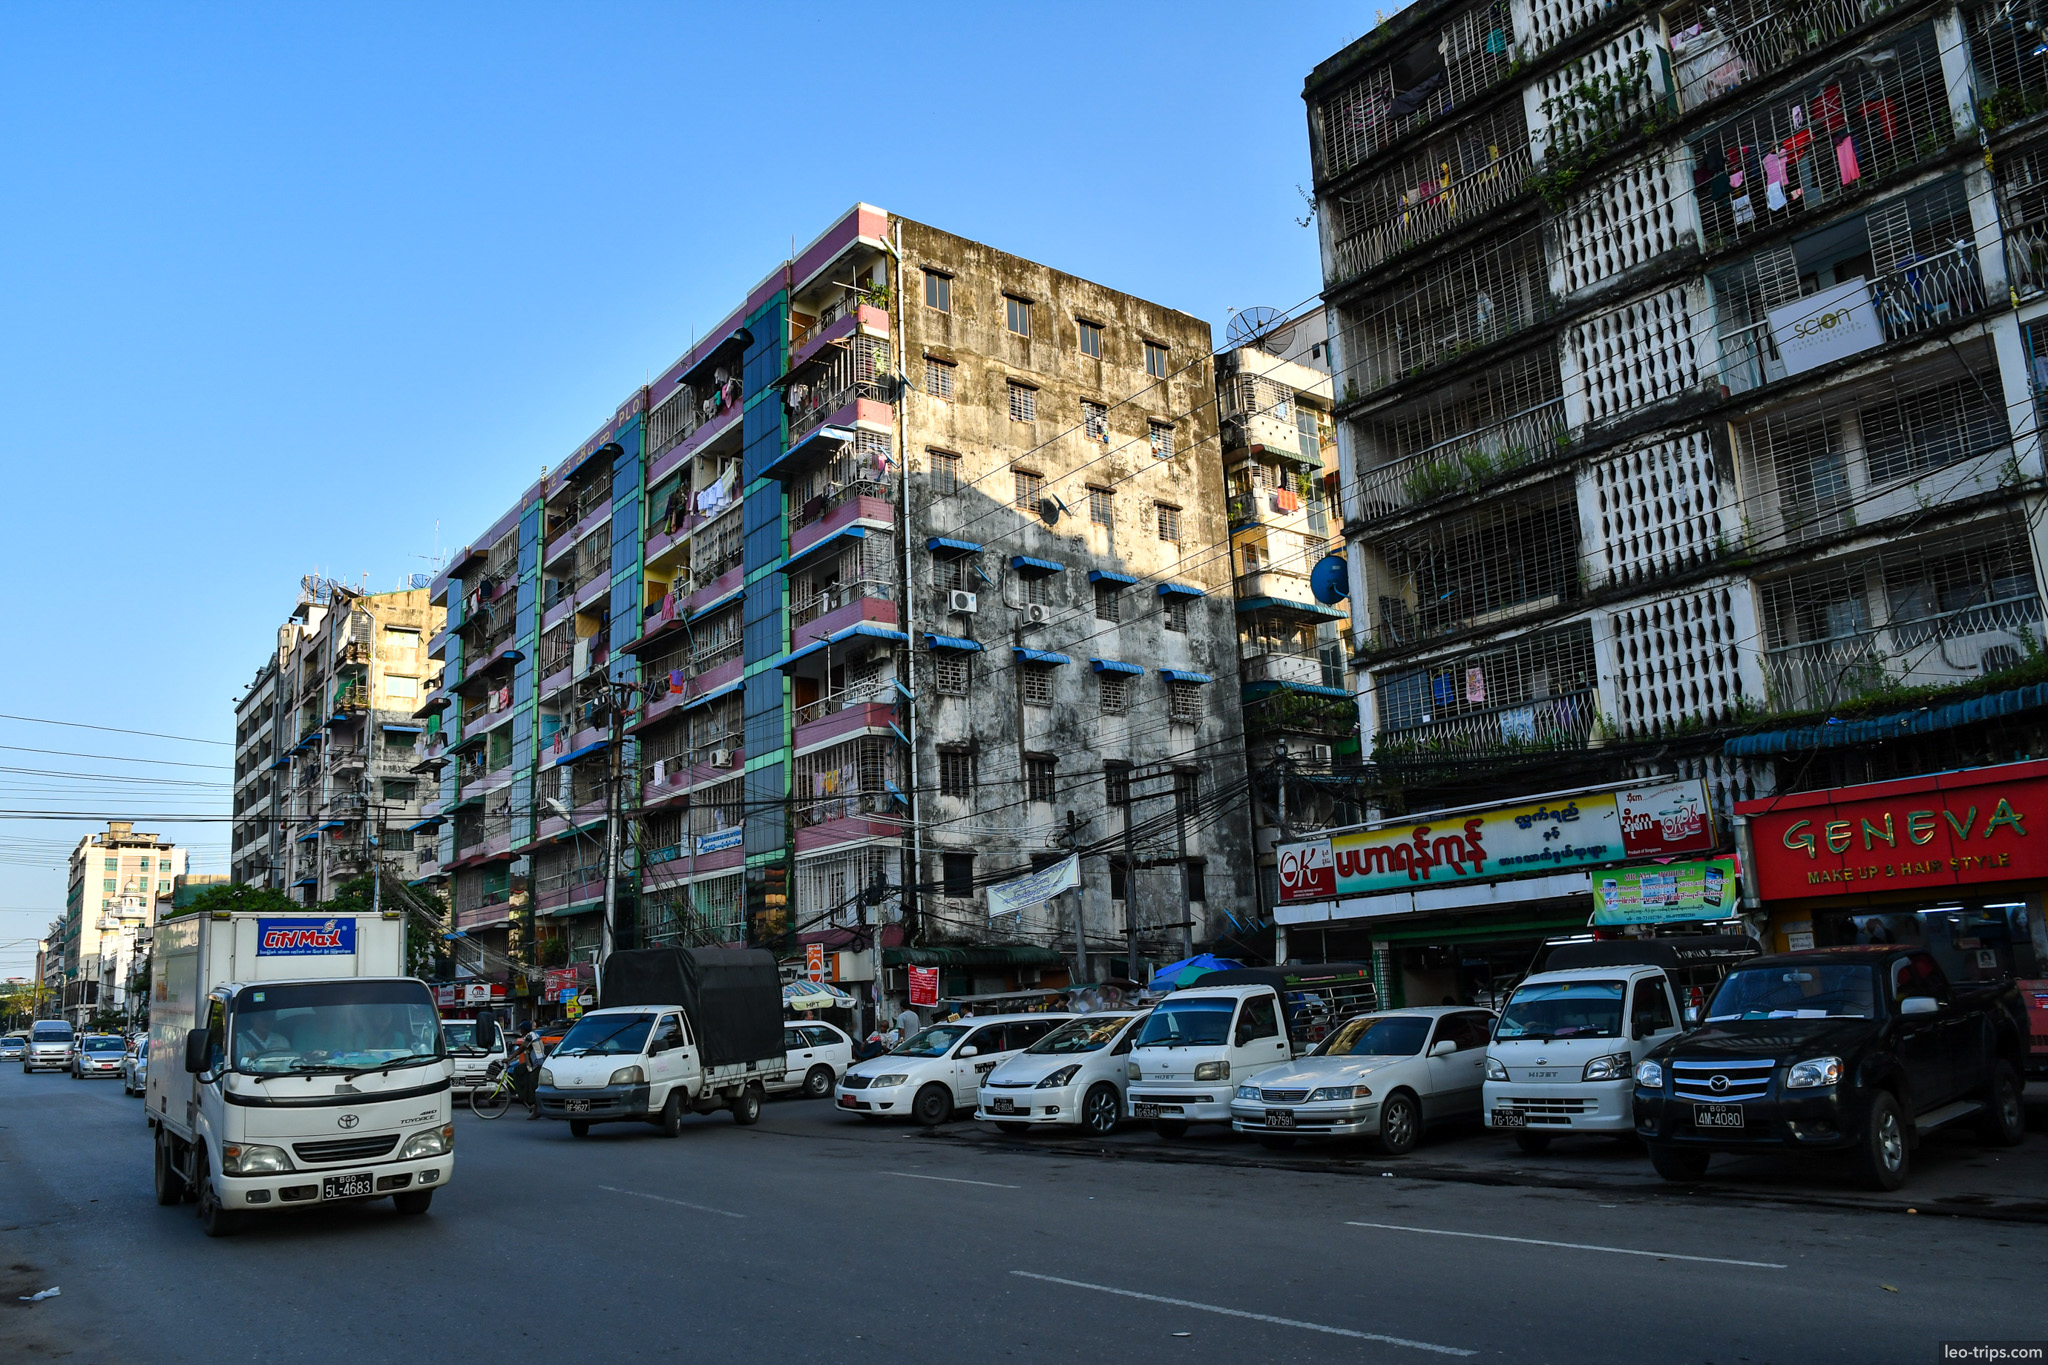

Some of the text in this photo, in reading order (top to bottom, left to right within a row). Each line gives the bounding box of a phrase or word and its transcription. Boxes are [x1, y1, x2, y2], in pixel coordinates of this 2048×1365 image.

[1794, 308, 1852, 339] scion
[1782, 798, 2028, 859] GENEVA
[1335, 818, 1488, 881] မဟာရန်ကုန်
[1279, 848, 1319, 888] OK
[1807, 853, 2011, 884] MAKE UP & HAIR STYLE
[400, 1115, 435, 1124] TOYOACE
[1493, 1115, 1523, 1126] 7G-1294
[1698, 1112, 1740, 1125] 4M-4080
[325, 1181, 371, 1198] 5L-4683
[340, 1175, 356, 1183] BGO
